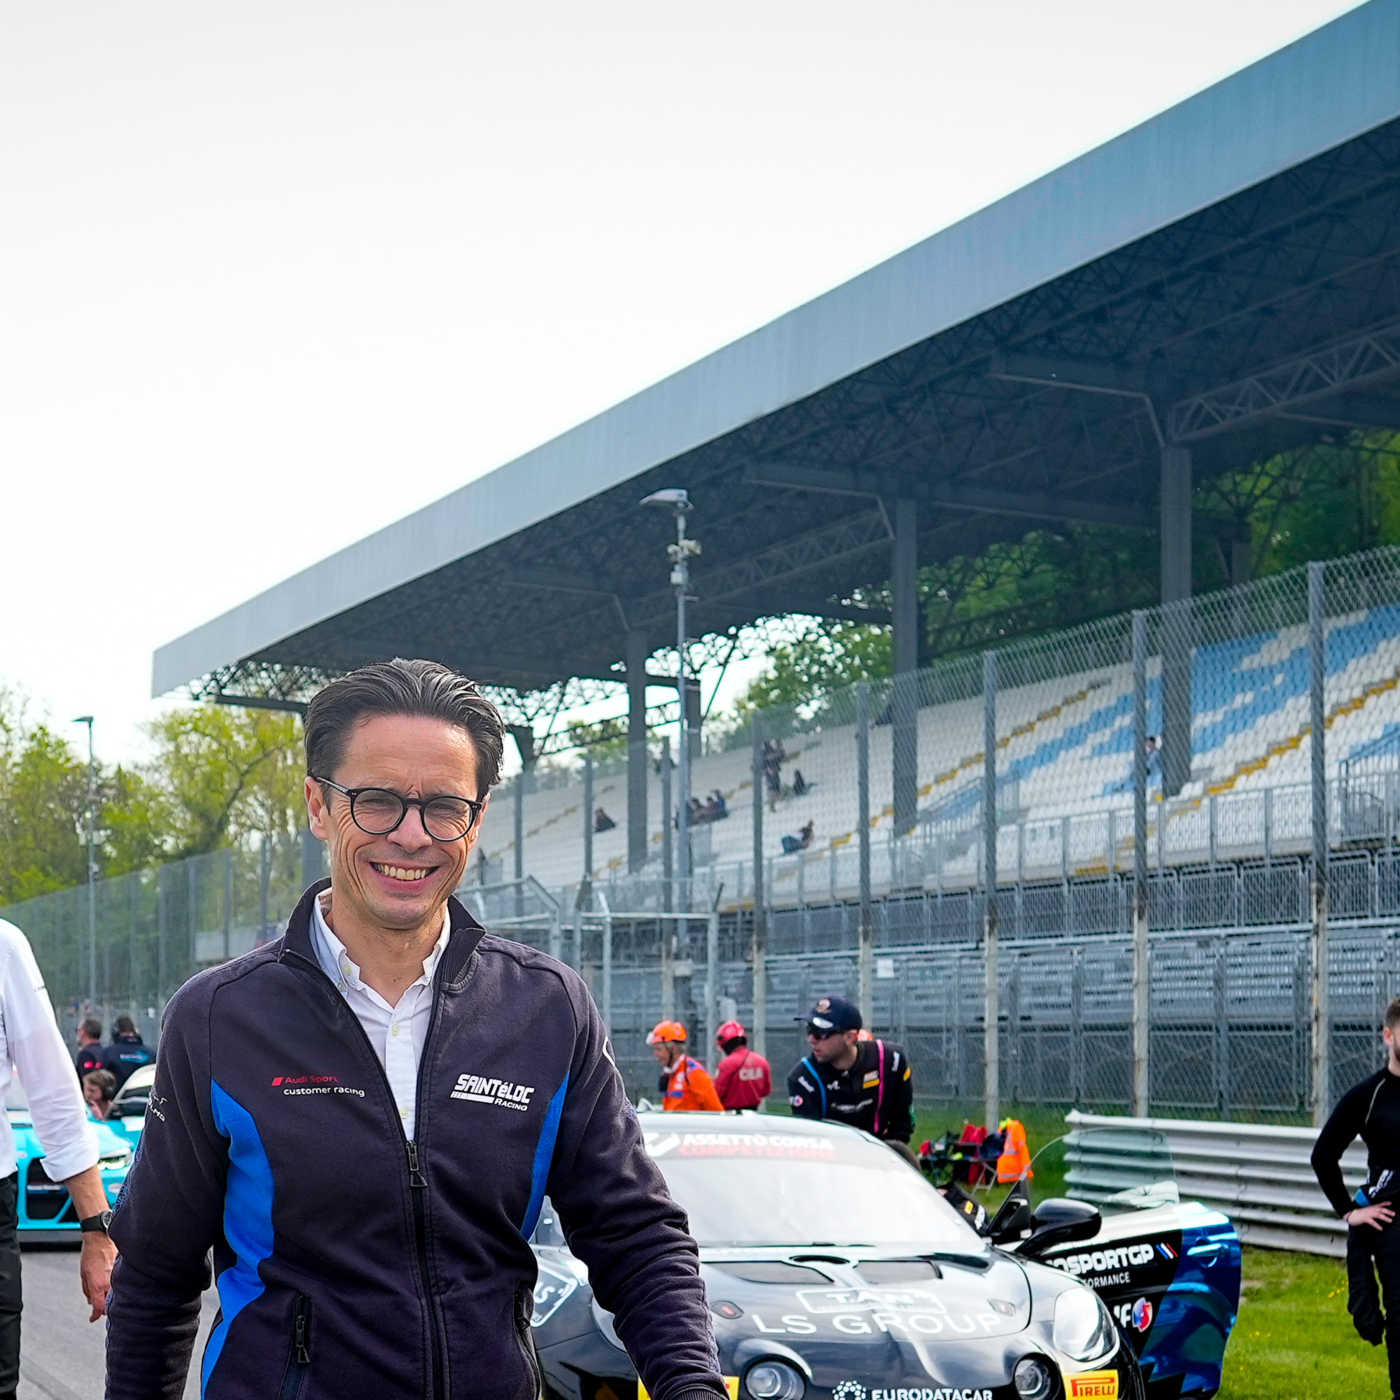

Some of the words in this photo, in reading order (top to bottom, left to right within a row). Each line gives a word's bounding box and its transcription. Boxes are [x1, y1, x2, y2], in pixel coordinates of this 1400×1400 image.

[283, 1087, 331, 1096] customer
[333, 1086, 365, 1098] racing
[494, 1098, 528, 1112] RACING
[751, 1313, 817, 1335] LS
[832, 1311, 1000, 1335] GROUP
[1070, 1376, 1116, 1398] PIRELLI
